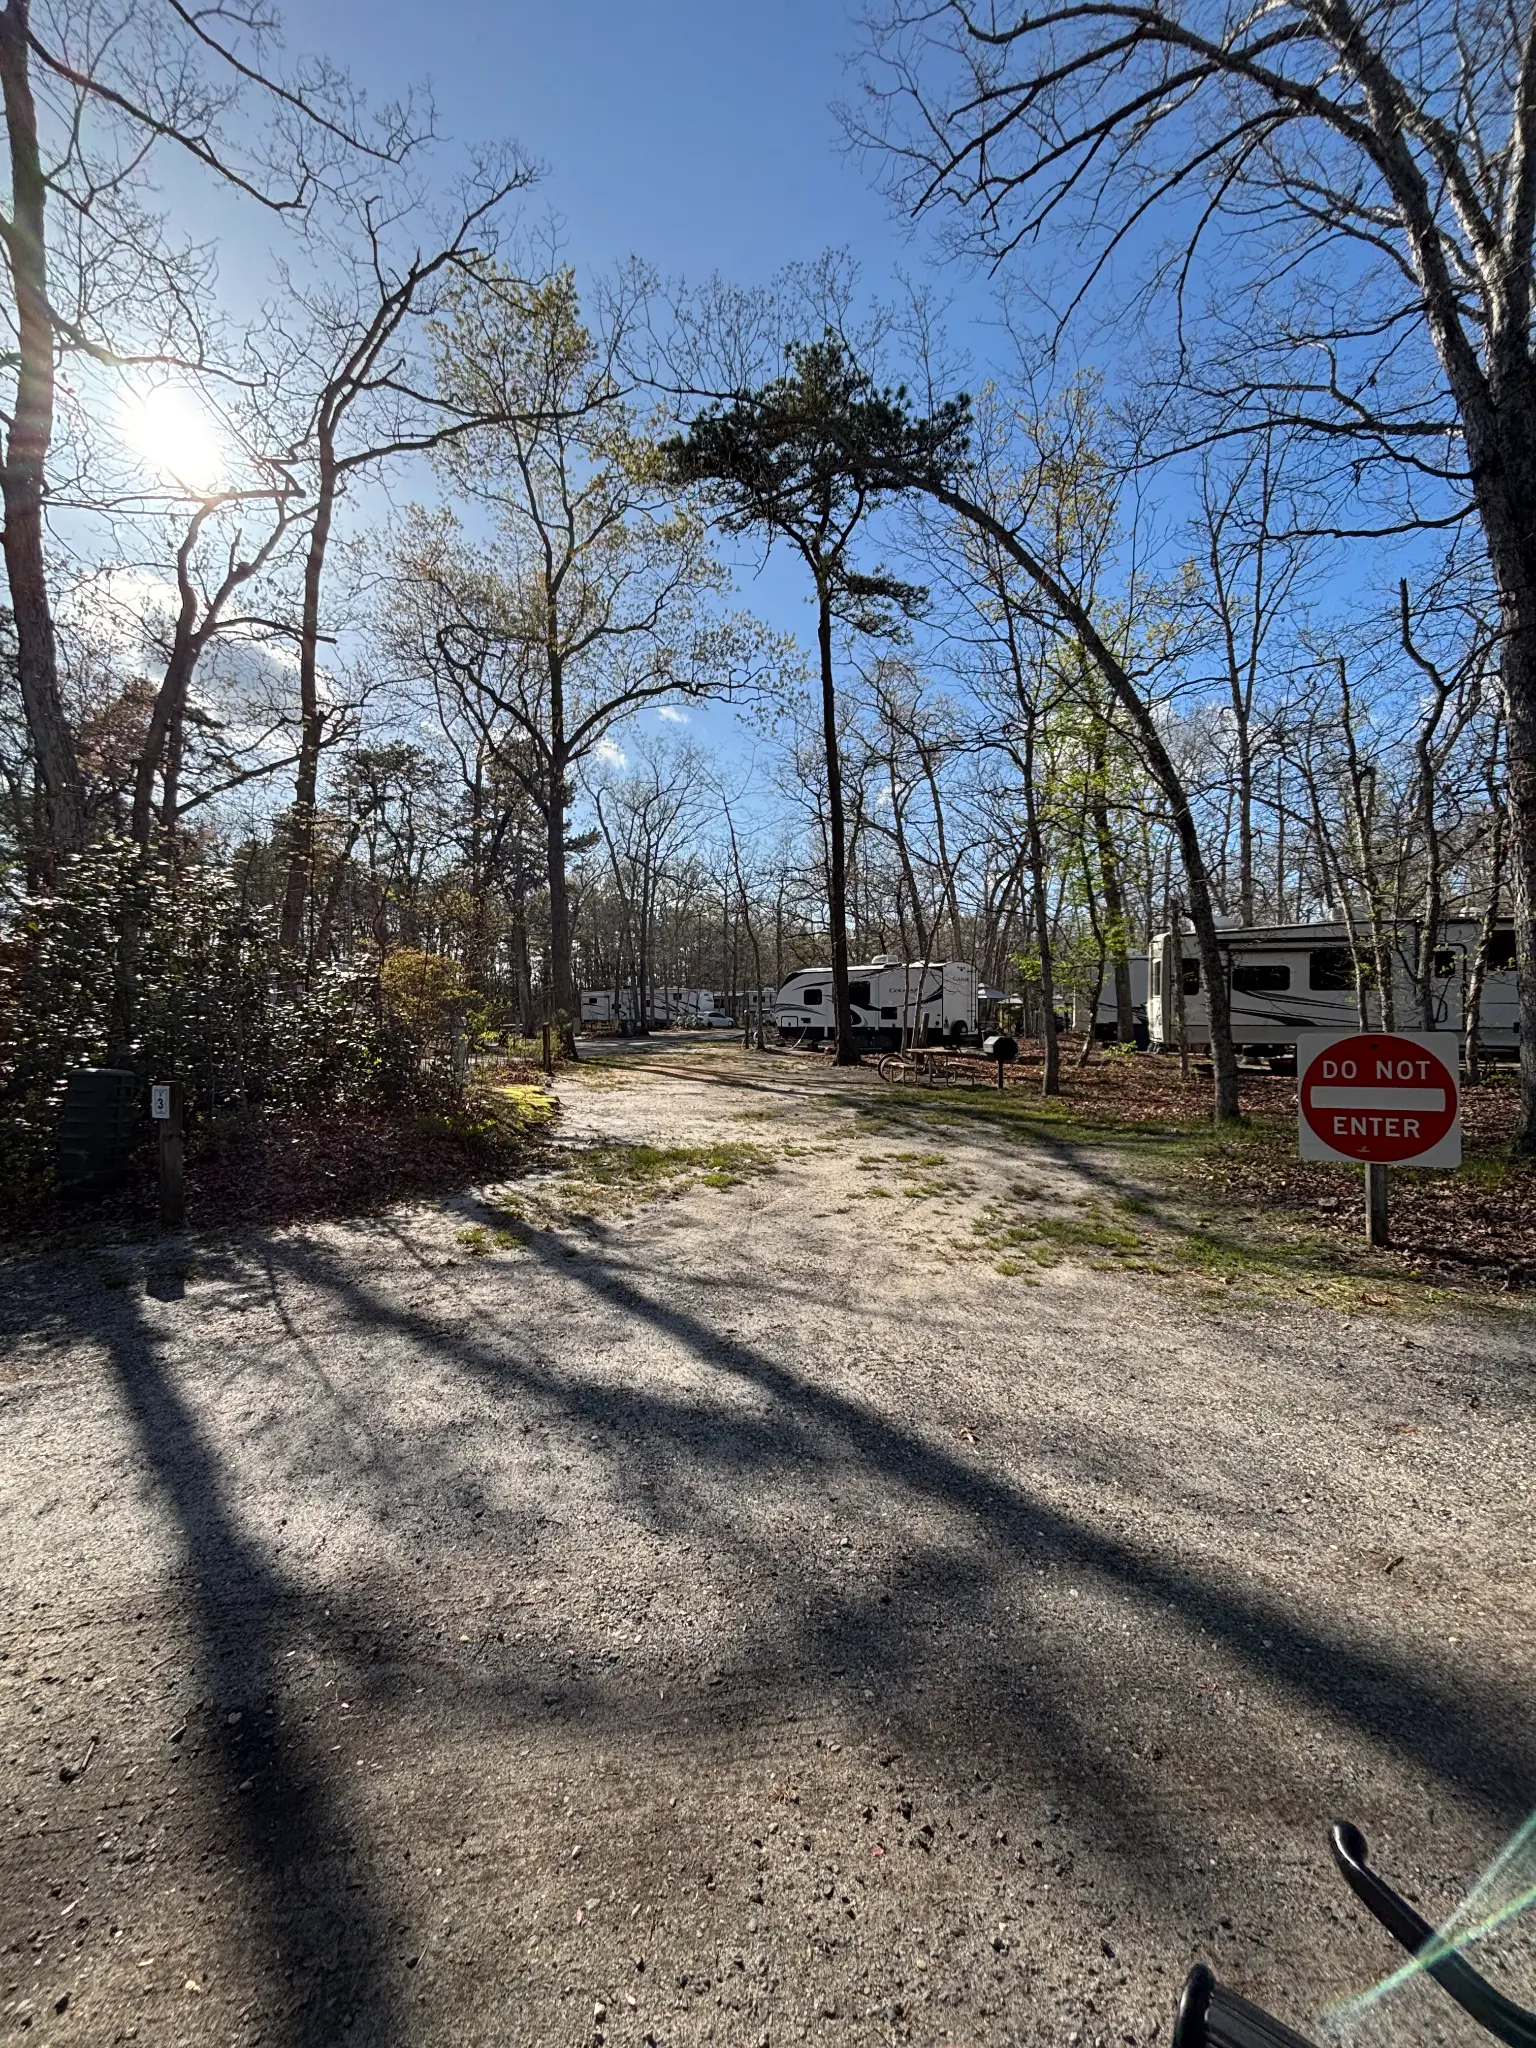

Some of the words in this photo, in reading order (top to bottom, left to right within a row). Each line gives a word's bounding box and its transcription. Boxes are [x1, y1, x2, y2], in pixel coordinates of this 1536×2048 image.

[1322, 1060, 1358, 1080] DO
[1376, 1060, 1431, 1080] NOT
[157, 1098, 164, 1110] 3
[1333, 1116, 1420, 1138] ENTER
